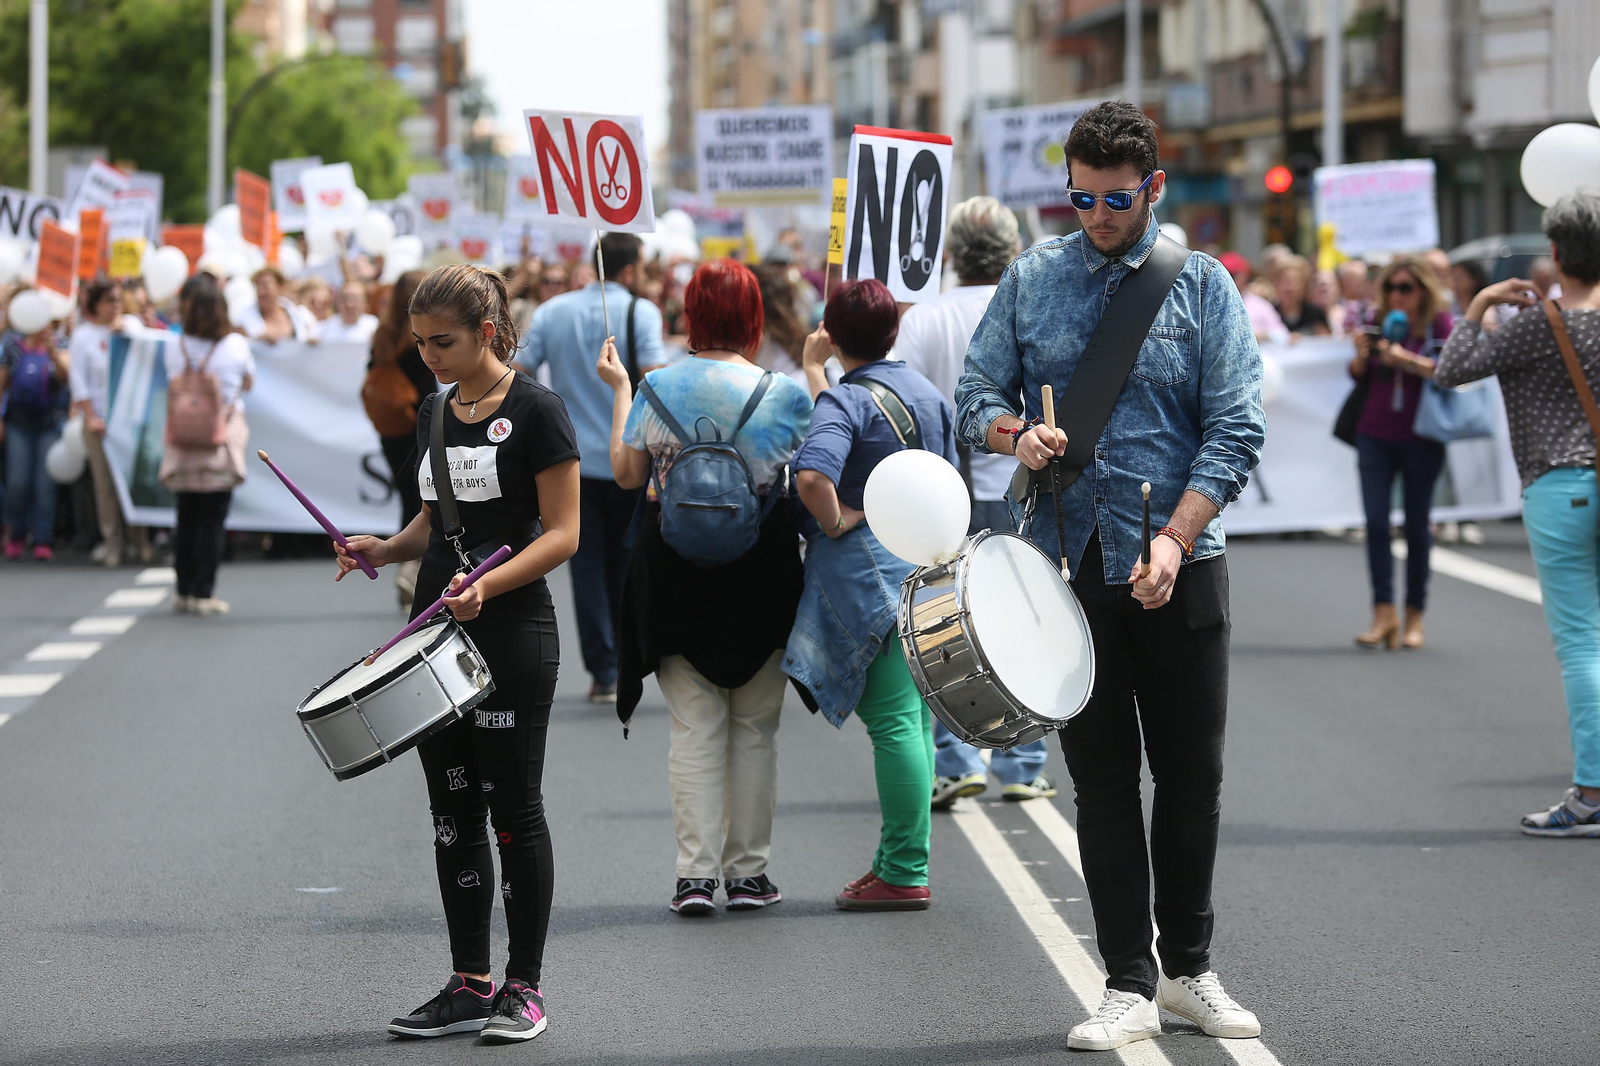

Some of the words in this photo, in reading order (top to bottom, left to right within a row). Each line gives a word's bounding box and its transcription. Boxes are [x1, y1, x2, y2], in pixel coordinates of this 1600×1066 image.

[529, 116, 643, 225] NO
[0, 194, 60, 241] NO
[847, 143, 943, 292] NO
[463, 459, 478, 470] NOT
[466, 477, 487, 488] BOYS
[475, 711, 513, 727] SUPERB
[447, 766, 468, 790] K
